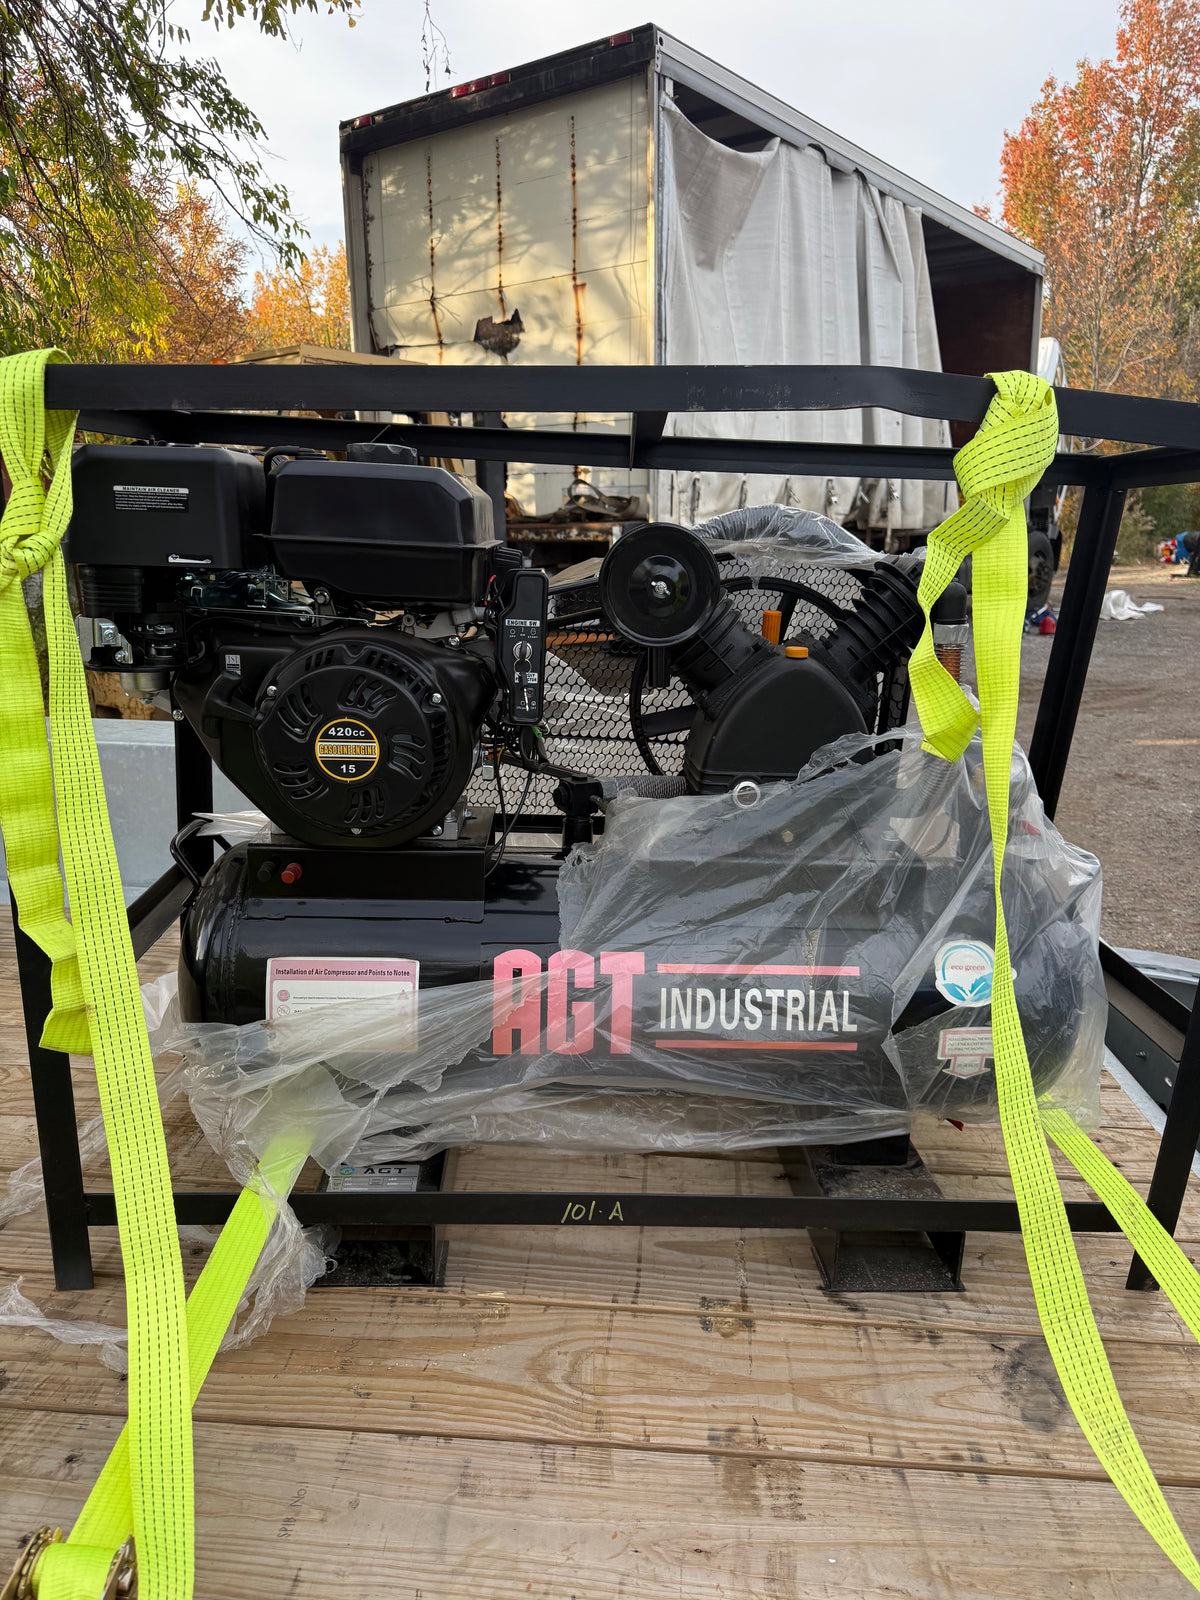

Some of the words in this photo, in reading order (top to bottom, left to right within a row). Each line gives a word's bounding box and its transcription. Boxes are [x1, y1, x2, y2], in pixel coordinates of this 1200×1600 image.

[328, 727, 366, 737] 420cc
[319, 744, 352, 755] GASOLINE
[352, 745, 377, 755] ENGINE
[340, 764, 356, 773] 15
[308, 968, 314, 976] of
[324, 968, 357, 977] Compressor
[659, 987, 858, 1032] INDUSTRIAL
[277, 1517, 297, 1538] SPIB
